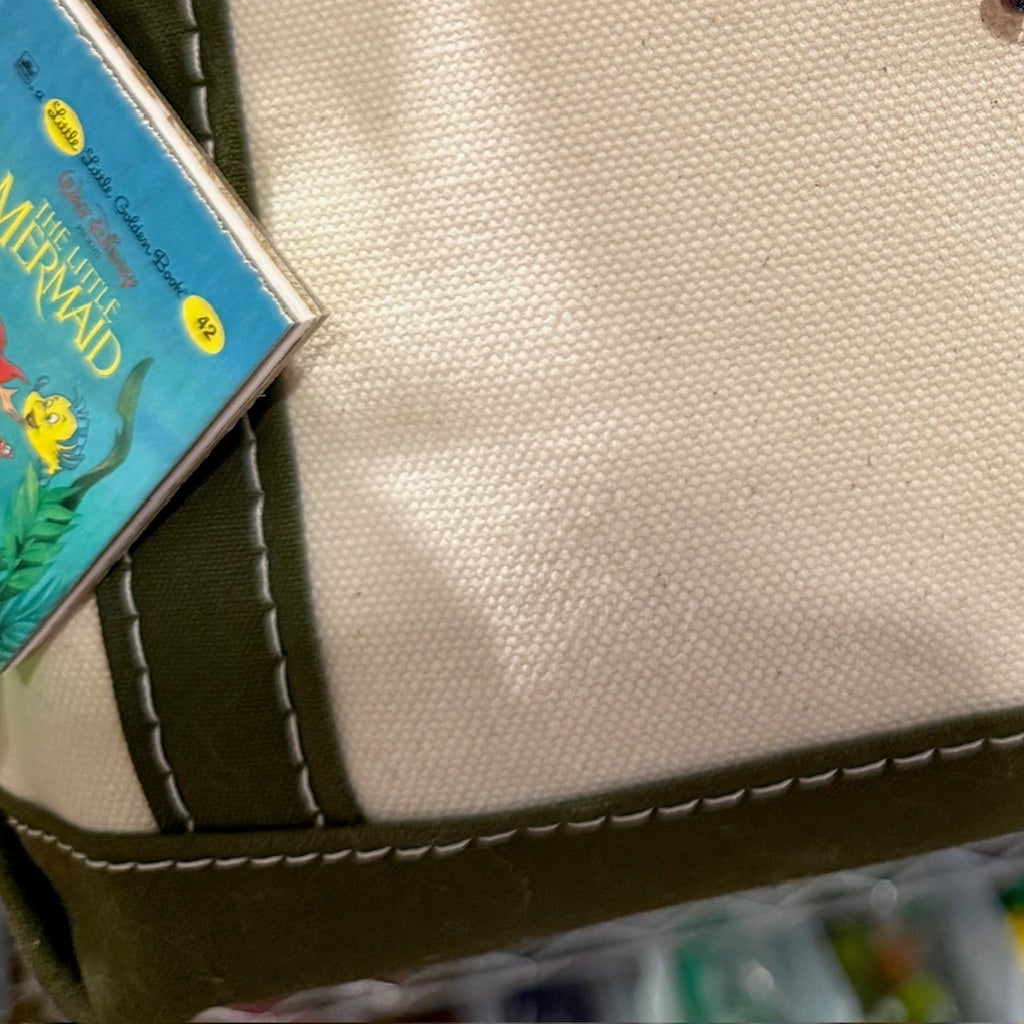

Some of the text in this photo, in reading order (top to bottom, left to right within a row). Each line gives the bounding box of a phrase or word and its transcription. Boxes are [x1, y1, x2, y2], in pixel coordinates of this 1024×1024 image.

[47, 100, 80, 152] Little
[81, 147, 113, 199] Little
[114, 195, 152, 256] Golden
[0, 169, 122, 378] MERMAID
[35, 198, 72, 251] THE
[66, 245, 121, 325] LITTLE
[197, 316, 217, 342] 42
